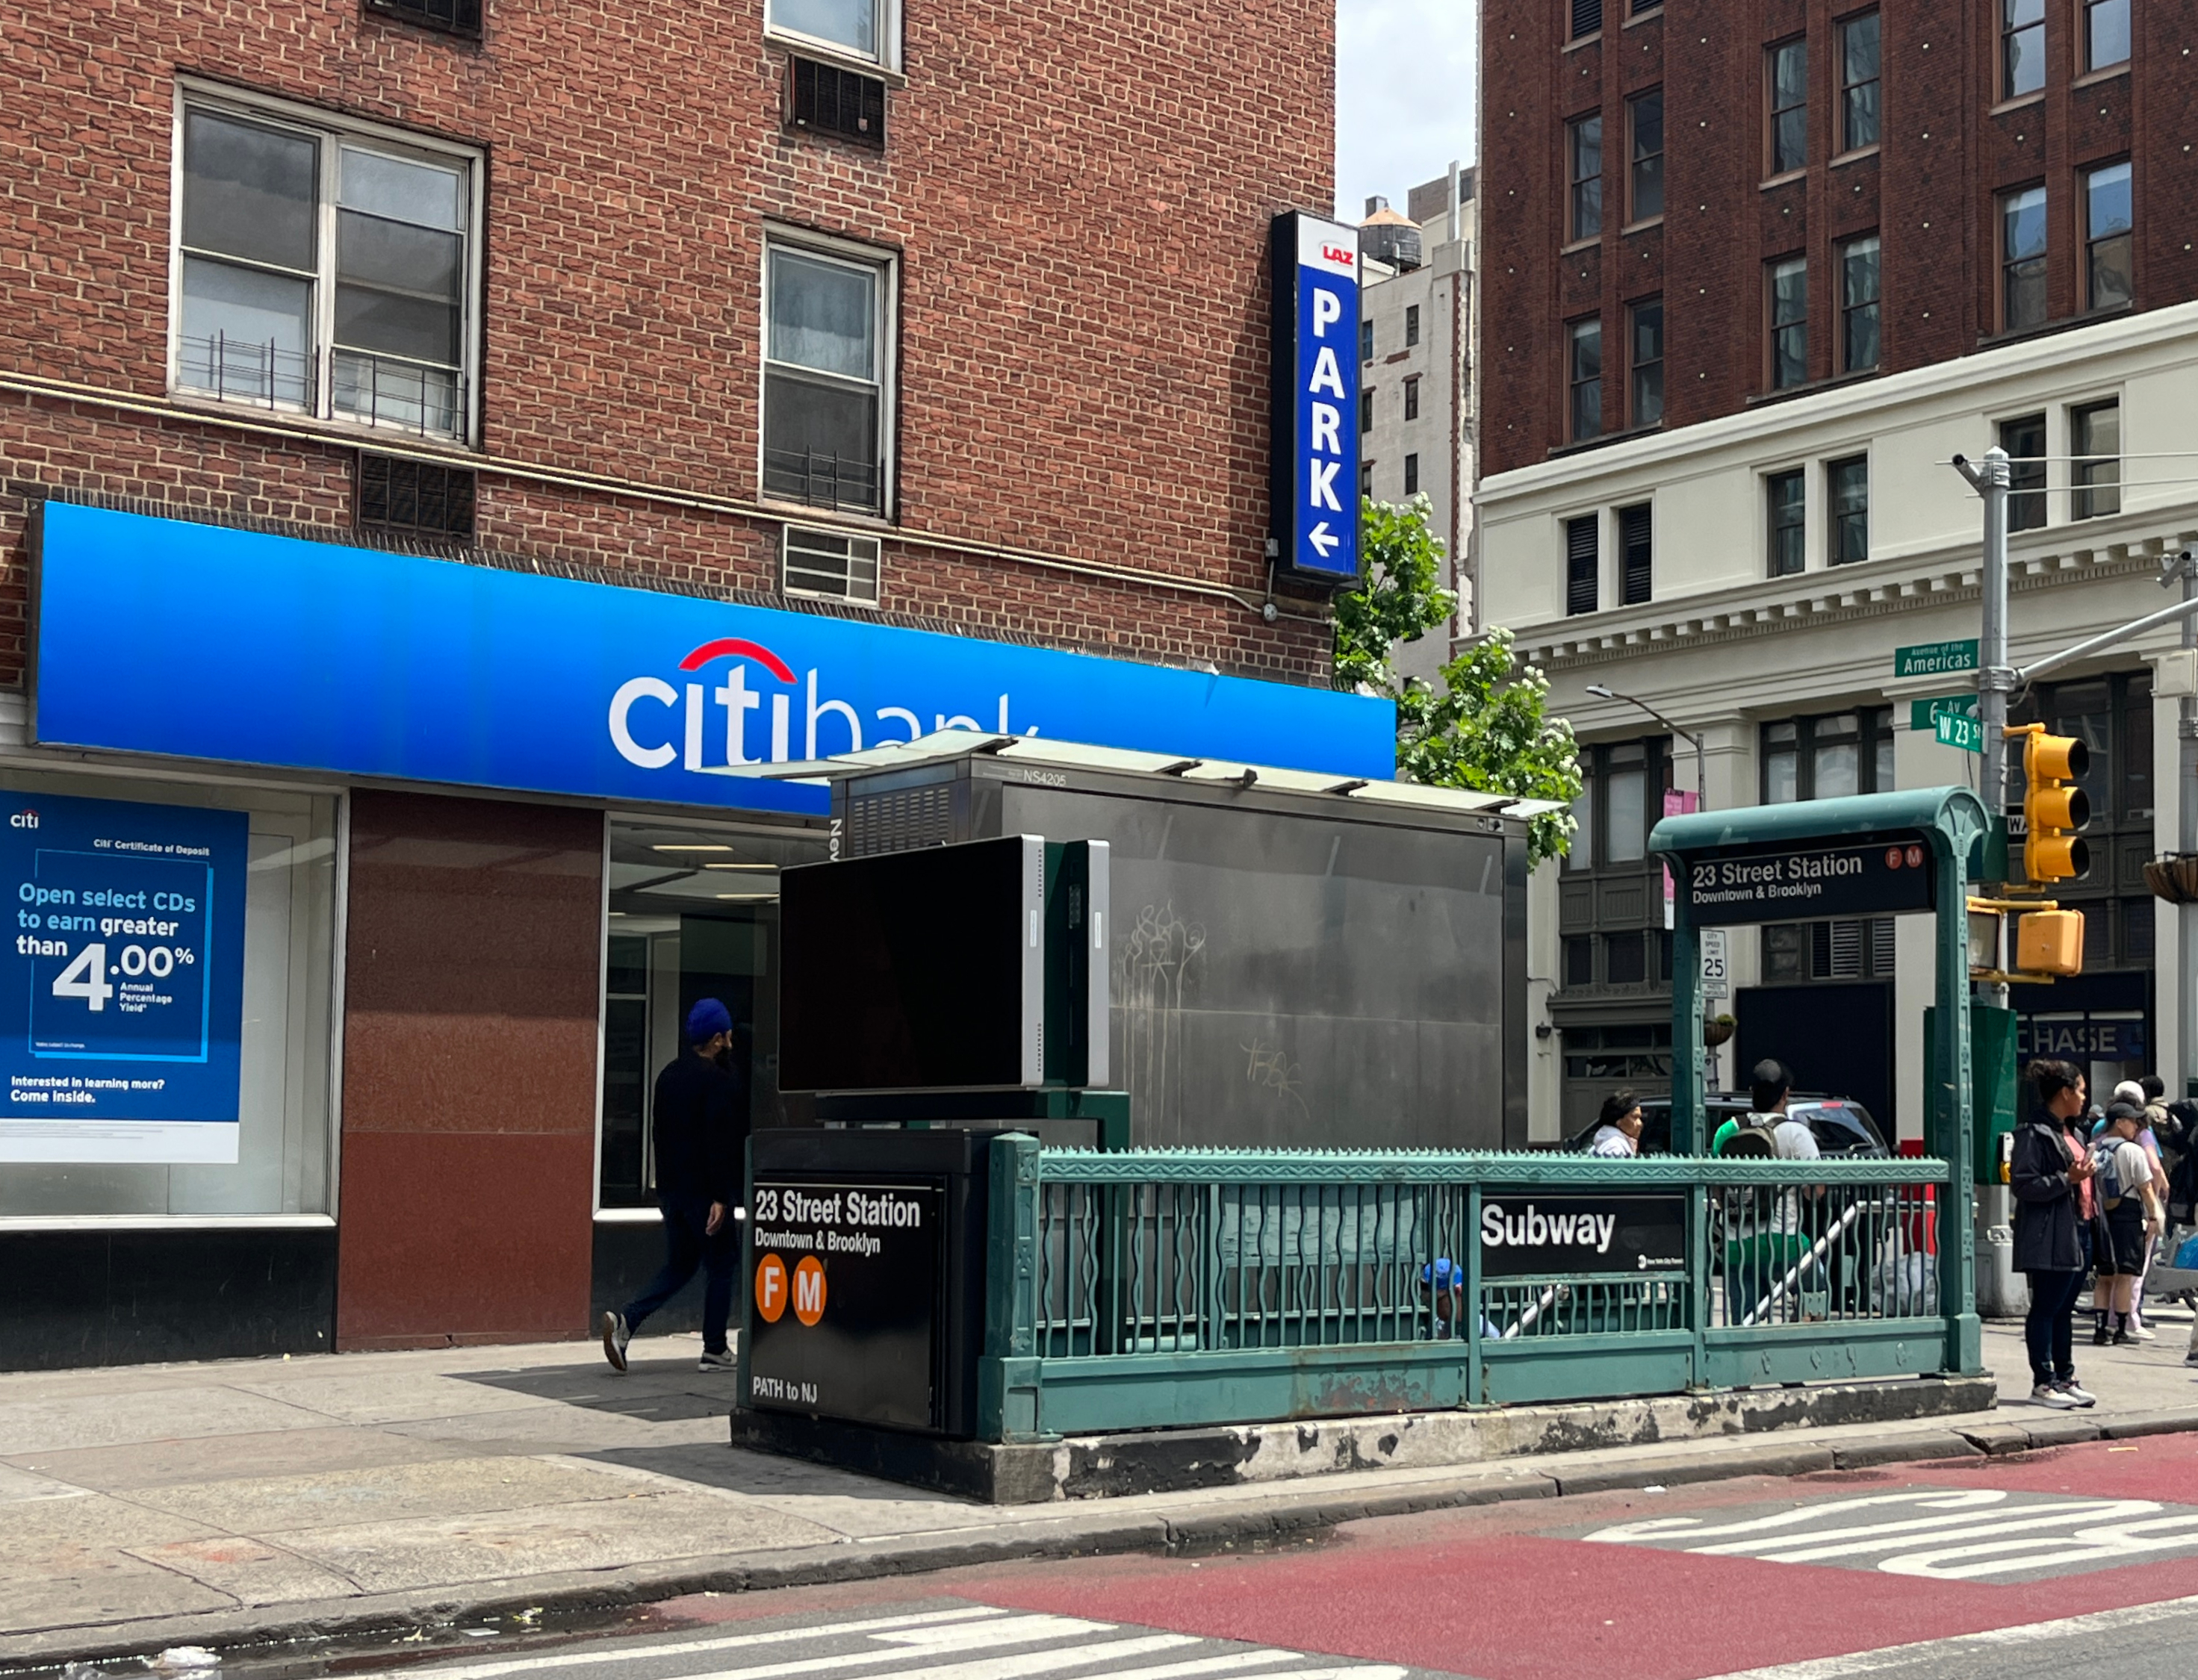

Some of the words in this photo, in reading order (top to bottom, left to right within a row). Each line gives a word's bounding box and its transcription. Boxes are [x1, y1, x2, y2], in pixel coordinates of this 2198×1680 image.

[1323, 245, 1353, 266] LAZ
[1308, 287, 1345, 512] PARK
[1911, 647, 1938, 656] Avenue
[1951, 643, 1964, 652] the
[1904, 653, 1971, 673] Americas
[609, 664, 1039, 770] citiba
[1940, 715, 1951, 740] W
[1955, 719, 1969, 744] 23
[1023, 770, 1067, 787] NS4205
[10, 813, 39, 829] citi
[114, 840, 163, 853] Certificate
[164, 844, 174, 853] of
[176, 845, 211, 856] Deposit
[1693, 865, 1716, 887] 23
[1722, 860, 1782, 885] Street
[1788, 853, 1863, 879] Station
[1889, 850, 1897, 865] F
[1907, 848, 1921, 865] M
[19, 883, 75, 906] Open
[82, 889, 147, 909] select
[153, 892, 196, 912] CDs
[1692, 888, 1753, 904] Downtown
[1756, 884, 1765, 899] &
[1768, 882, 1822, 898] Brooklyn
[17, 909, 41, 929] to
[47, 915, 96, 932] earn
[100, 917, 179, 937] greater
[16, 935, 69, 956] than
[1704, 958, 1724, 977] 25
[120, 982, 154, 992] Annual
[119, 992, 173, 1005] Percentage
[2017, 1027, 2117, 1054] CHASE
[11, 1075, 69, 1087] Interested
[71, 1077, 82, 1088] in
[84, 1077, 128, 1090] learning
[131, 1079, 165, 1089] more?
[10, 1089, 49, 1102] Come
[52, 1090, 96, 1104] inside.
[755, 1189, 778, 1221] 23
[782, 1189, 841, 1224] Street
[845, 1191, 920, 1227] Station
[1480, 1204, 1615, 1254] Subway
[755, 1227, 813, 1249] Downtown
[816, 1230, 825, 1250] &
[828, 1231, 881, 1257] Brooklyn
[764, 1266, 780, 1308] F
[798, 1270, 821, 1313] M
[753, 1376, 783, 1399] PATH
[786, 1380, 799, 1400] to
[801, 1383, 818, 1403] NJ
